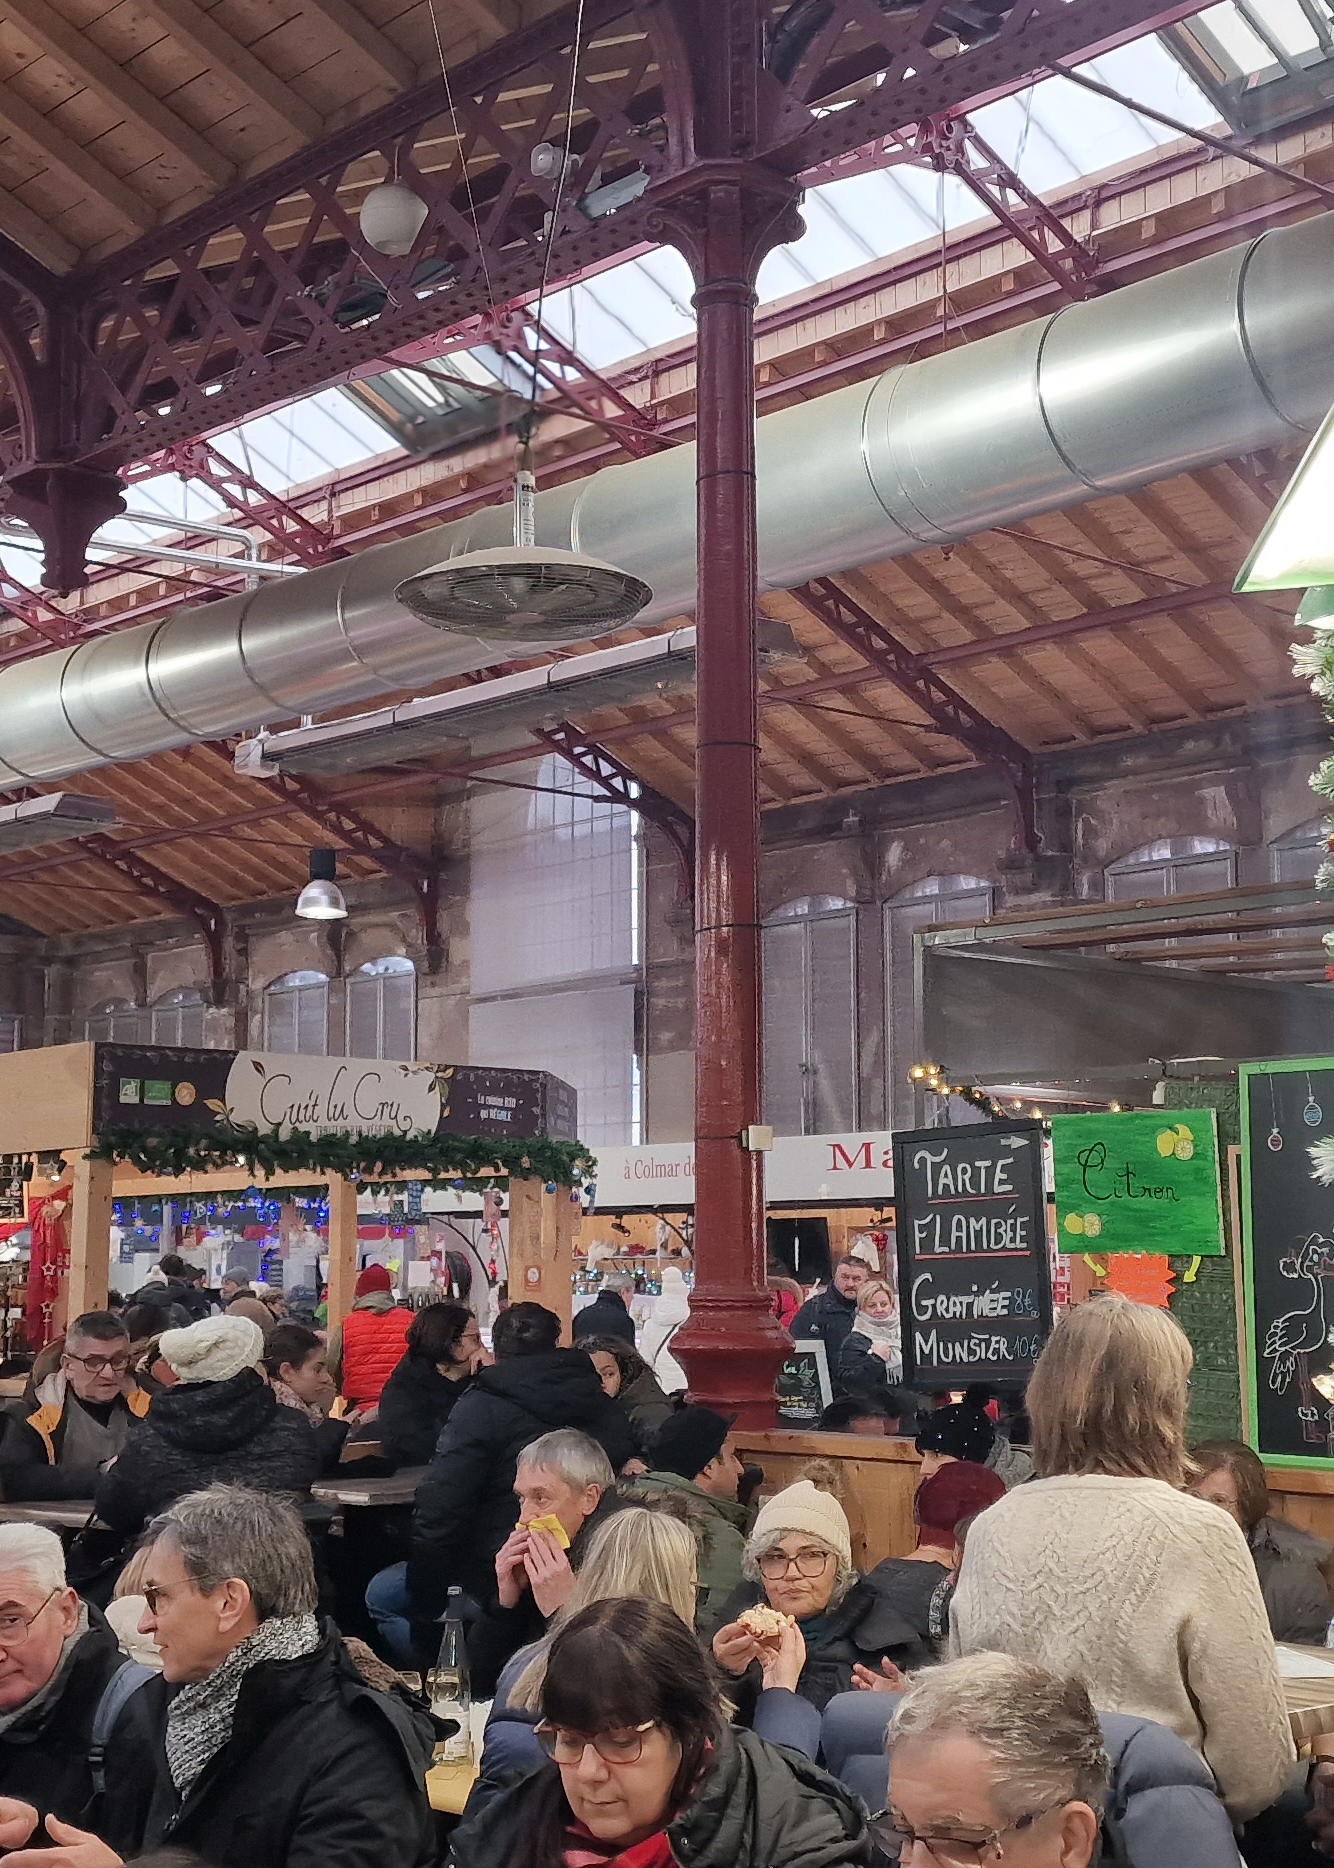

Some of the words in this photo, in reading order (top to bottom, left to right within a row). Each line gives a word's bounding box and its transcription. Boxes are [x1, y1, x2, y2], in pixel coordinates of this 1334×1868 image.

[260, 1072, 320, 1126] Cuit
[354, 1072, 413, 1132] Cru
[624, 1159, 630, 1179] à
[634, 1157, 680, 1179] Colmar
[913, 1147, 1014, 1198] TARTE
[1077, 1141, 1181, 1202] Citron
[913, 1203, 1030, 1255] FLAMBÉE
[915, 1328, 1014, 1367] MUNSTER
